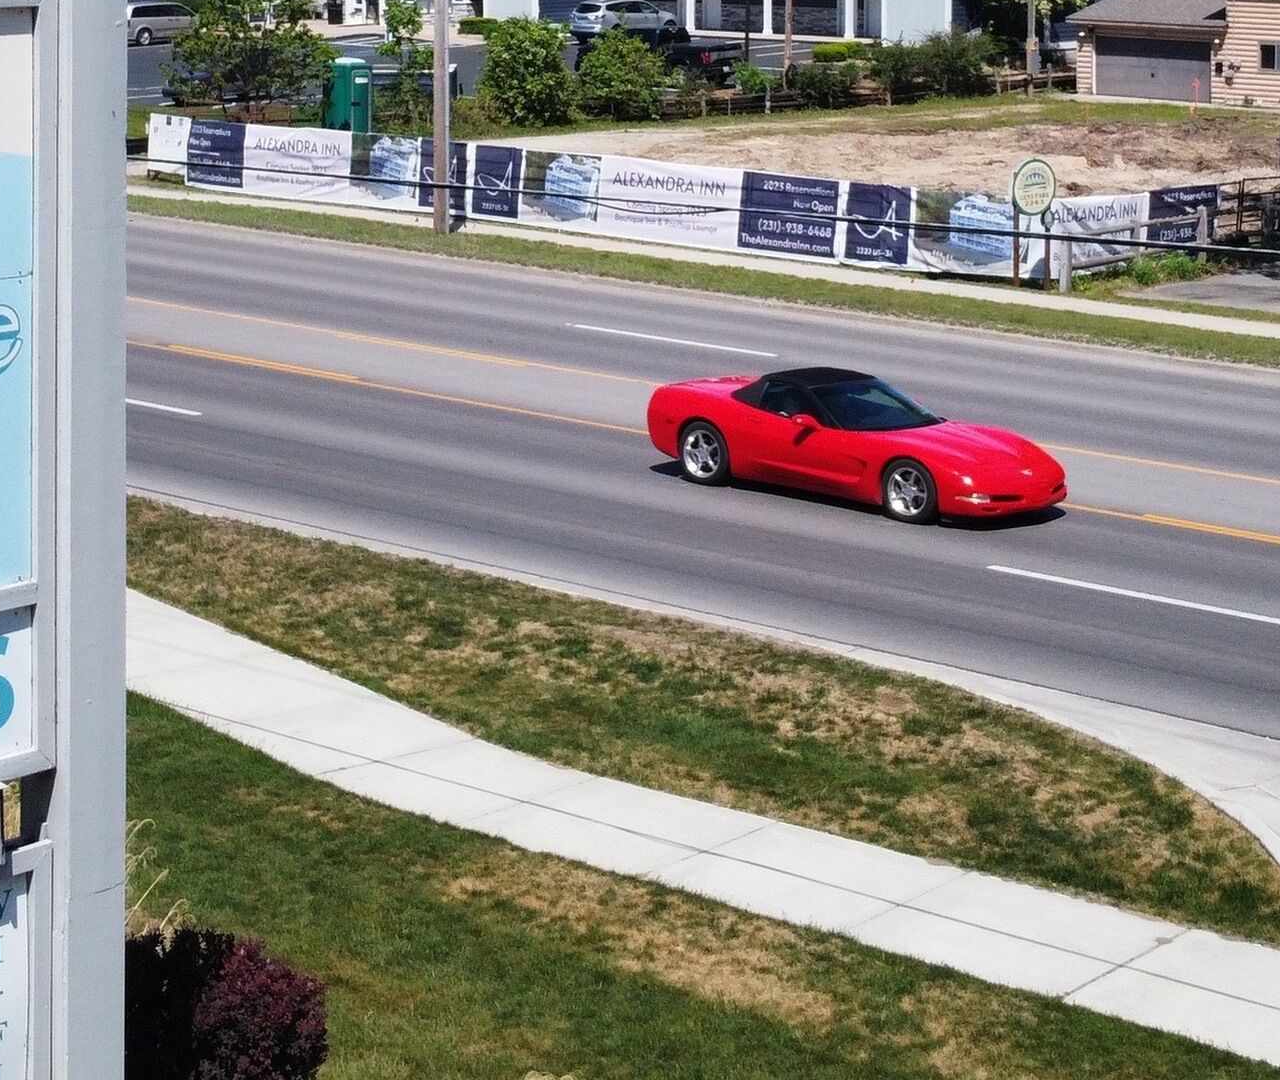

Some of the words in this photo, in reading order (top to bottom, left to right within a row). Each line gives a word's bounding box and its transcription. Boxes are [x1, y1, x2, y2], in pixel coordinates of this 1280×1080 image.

[254, 137, 318, 154] ALEXANDRA
[321, 143, 341, 156] INN
[612, 171, 695, 193] ALEXANDRA
[700, 179, 726, 197] INN
[763, 180, 784, 191] 2023
[785, 183, 835, 197] Reservations
[811, 200, 834, 212] Open
[1053, 204, 1117, 224] ALEXANDRA
[1119, 202, 1138, 219] INN
[758, 218, 832, 238] (231)-938-6468
[741, 233, 831, 253] TheAlexandraInn.com
